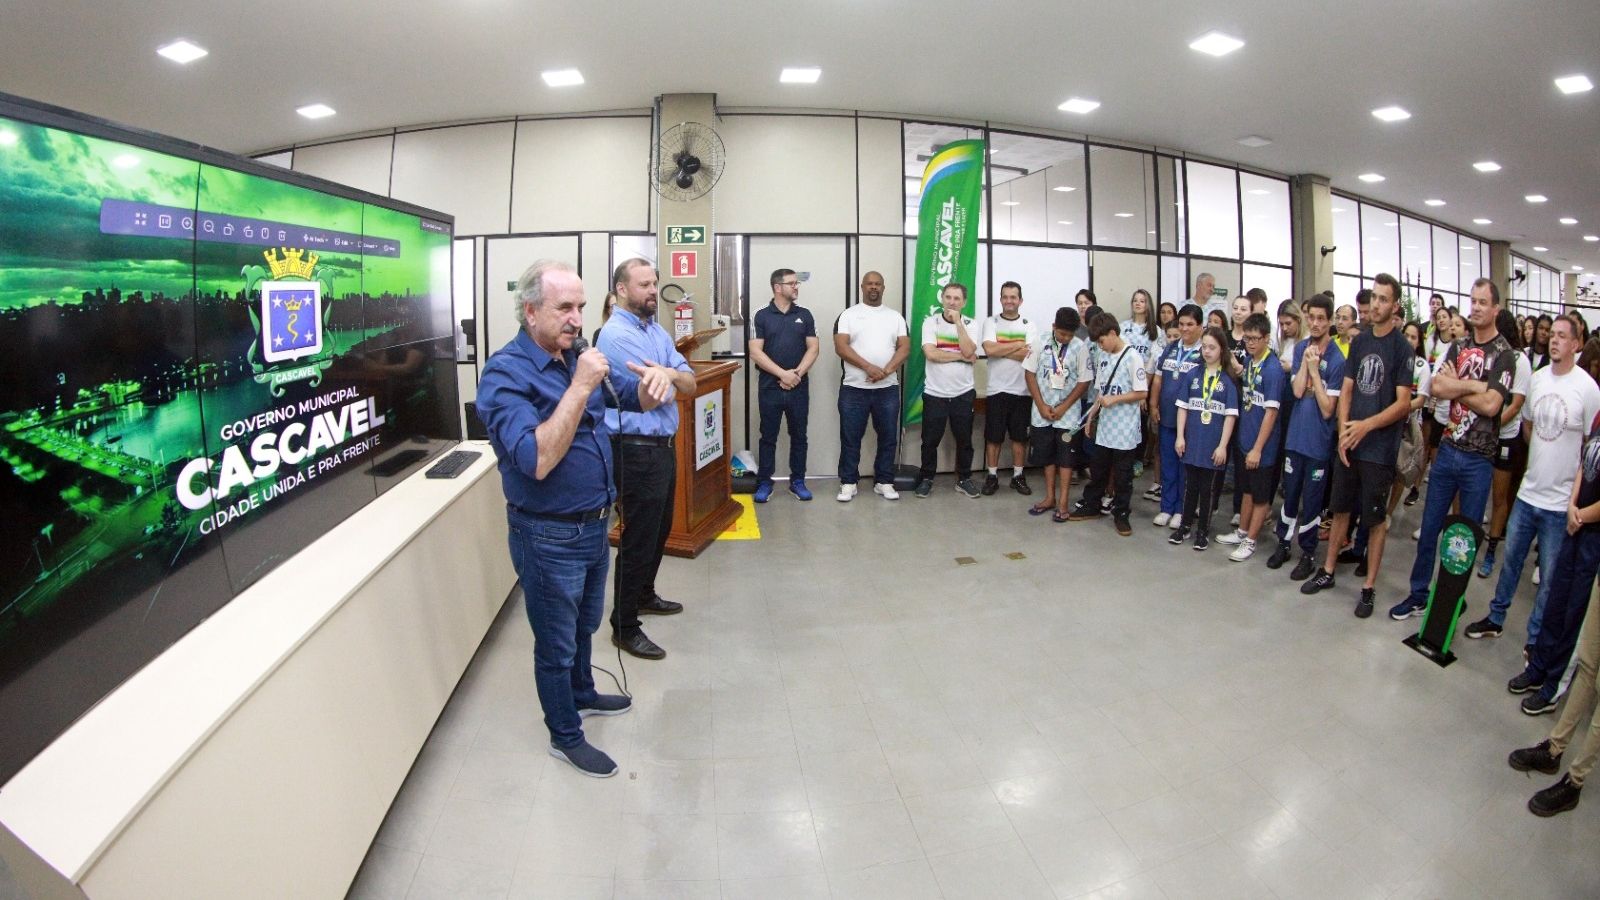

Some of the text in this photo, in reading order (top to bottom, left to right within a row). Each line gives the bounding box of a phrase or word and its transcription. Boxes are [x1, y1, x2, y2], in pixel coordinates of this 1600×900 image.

[934, 212, 942, 250] MUNICIPAL
[275, 367, 317, 384] CASCAVEL
[220, 386, 359, 441] GOVERNO MUNICIPAL
[176, 396, 385, 511] CASCAVEL
[199, 434, 381, 535] CIDADE UNIDA E PRA FRENTE
